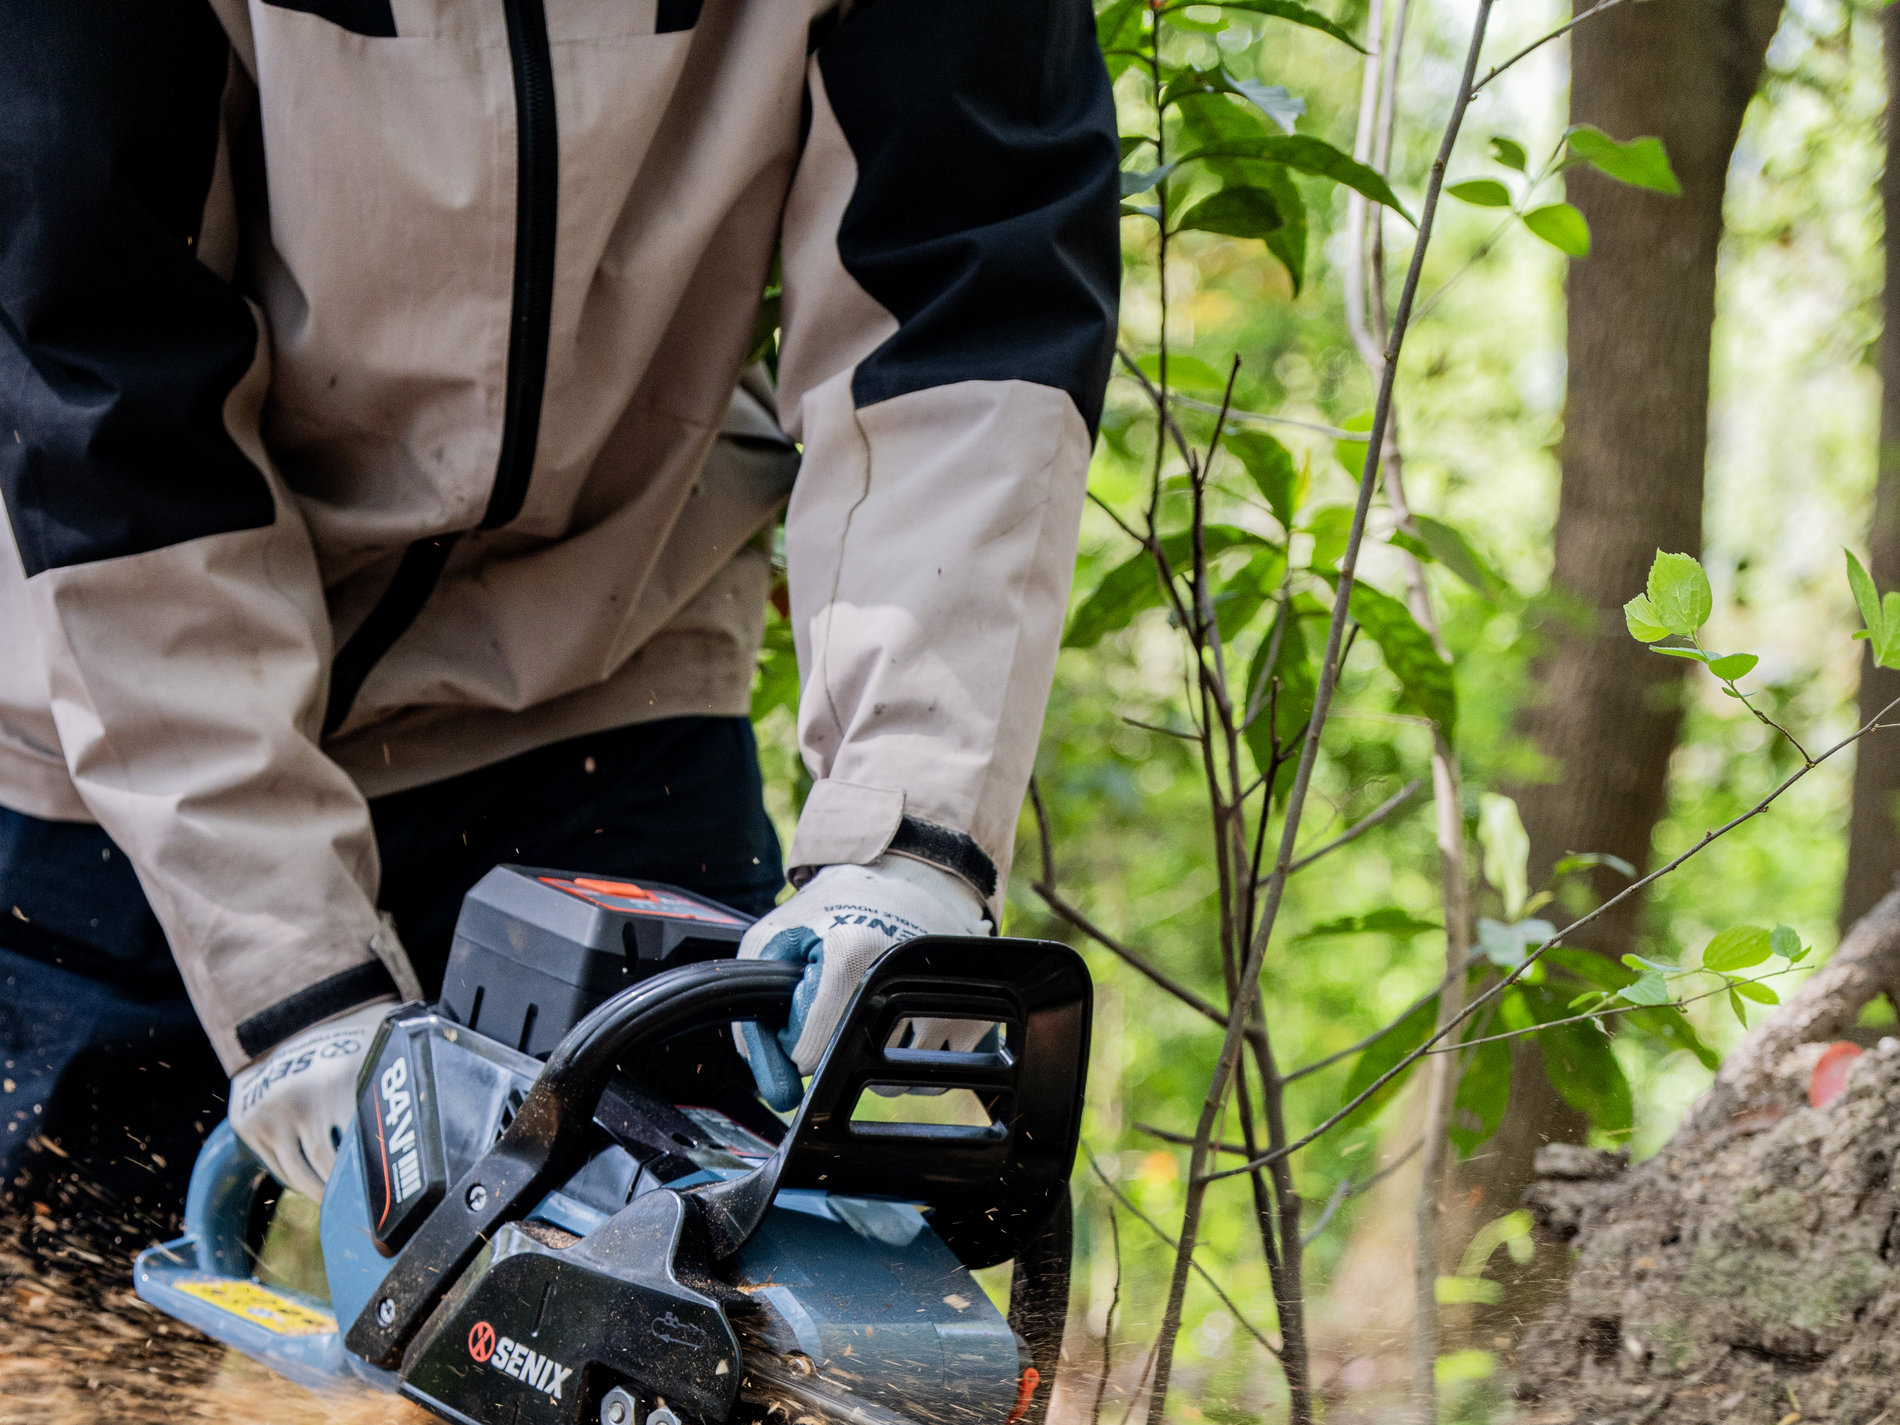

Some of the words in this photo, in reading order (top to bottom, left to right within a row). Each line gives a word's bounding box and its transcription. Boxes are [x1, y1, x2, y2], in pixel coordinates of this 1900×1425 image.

[827, 913, 919, 942] ENIX
[381, 1056, 416, 1155] 84V
[491, 1336, 573, 1399] SENIX
